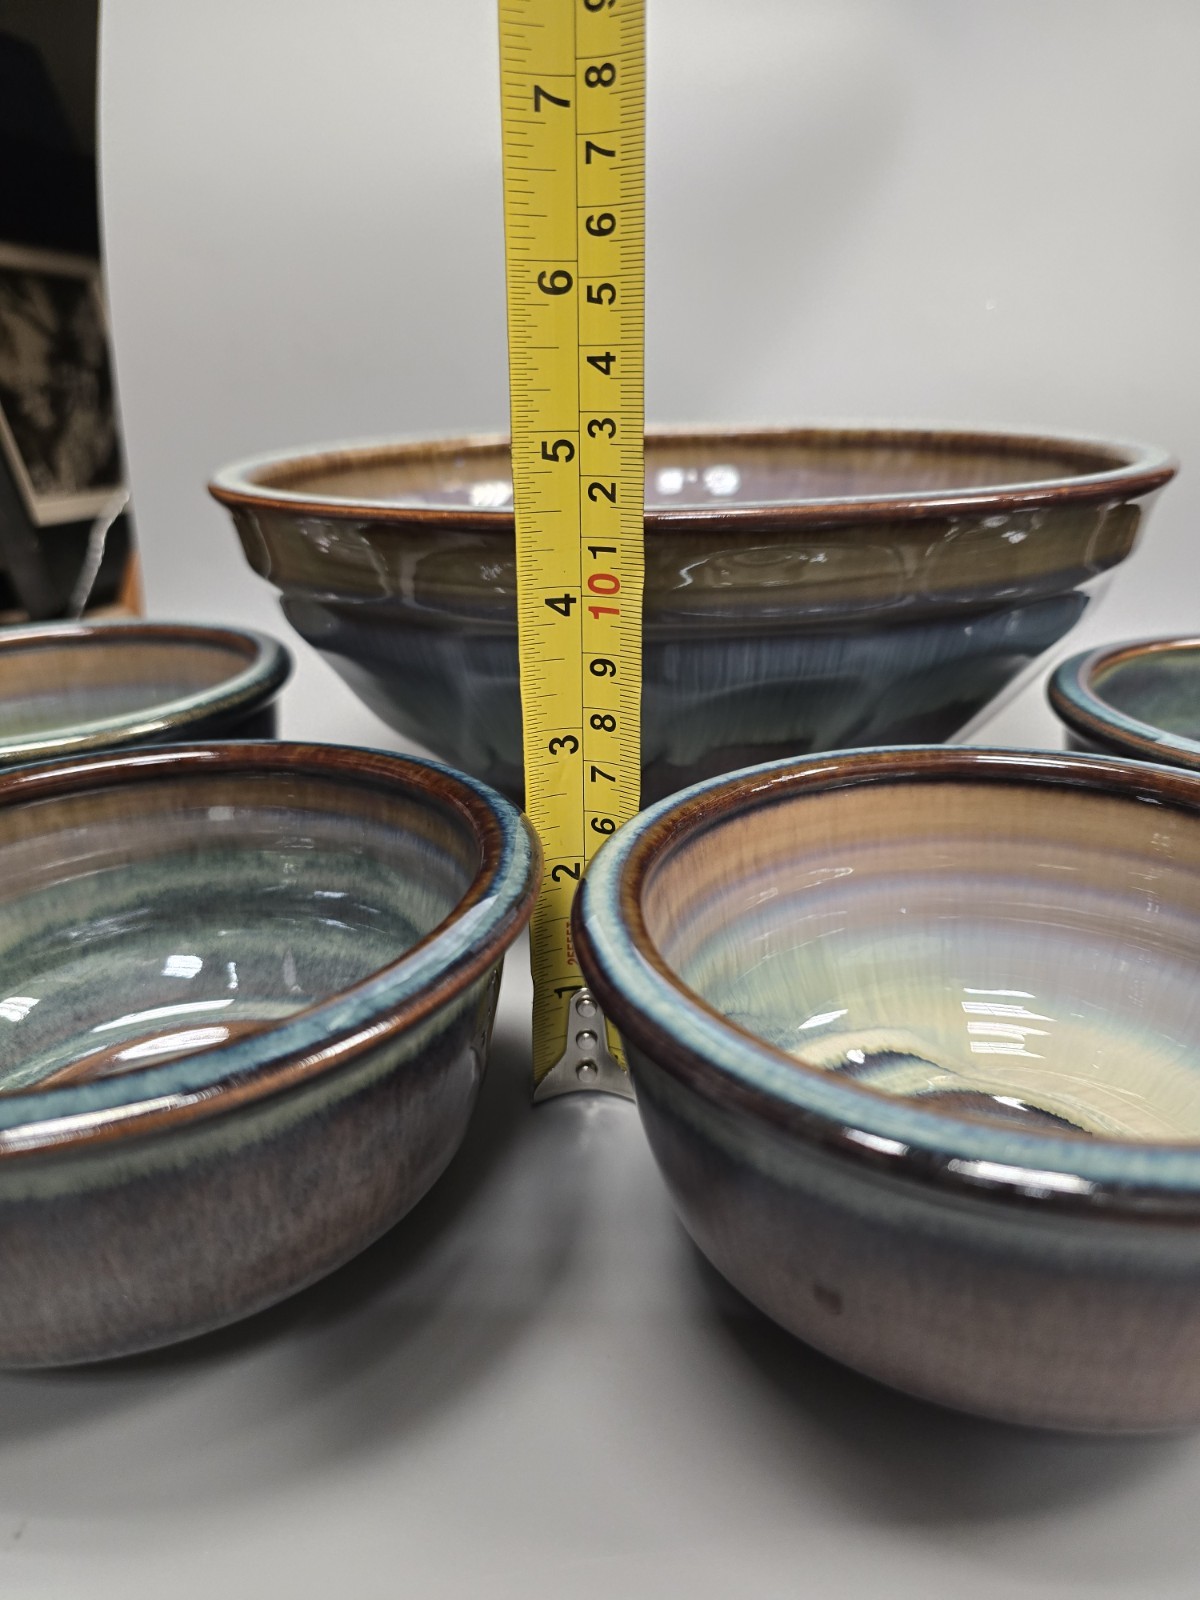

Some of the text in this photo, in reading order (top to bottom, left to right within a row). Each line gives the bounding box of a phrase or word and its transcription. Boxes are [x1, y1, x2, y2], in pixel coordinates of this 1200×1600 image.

[584, 62, 616, 89] 8
[533, 84, 571, 113] 7
[585, 140, 616, 165] 7
[585, 212, 617, 237] 6
[537, 269, 574, 296] 6
[586, 282, 617, 306] 5
[586, 351, 616, 376] 4
[587, 417, 617, 439] 3
[541, 439, 575, 463] 5
[587, 481, 617, 504] 2
[587, 545, 617, 560] 1
[544, 593, 577, 617] 4
[588, 573, 621, 620] 10
[589, 658, 617, 678] 9
[589, 713, 617, 733] 8
[548, 734, 579, 756] 3
[590, 765, 616, 783] 7
[590, 817, 616, 835] 6
[551, 862, 581, 883] 2
[553, 984, 583, 1000] 1
